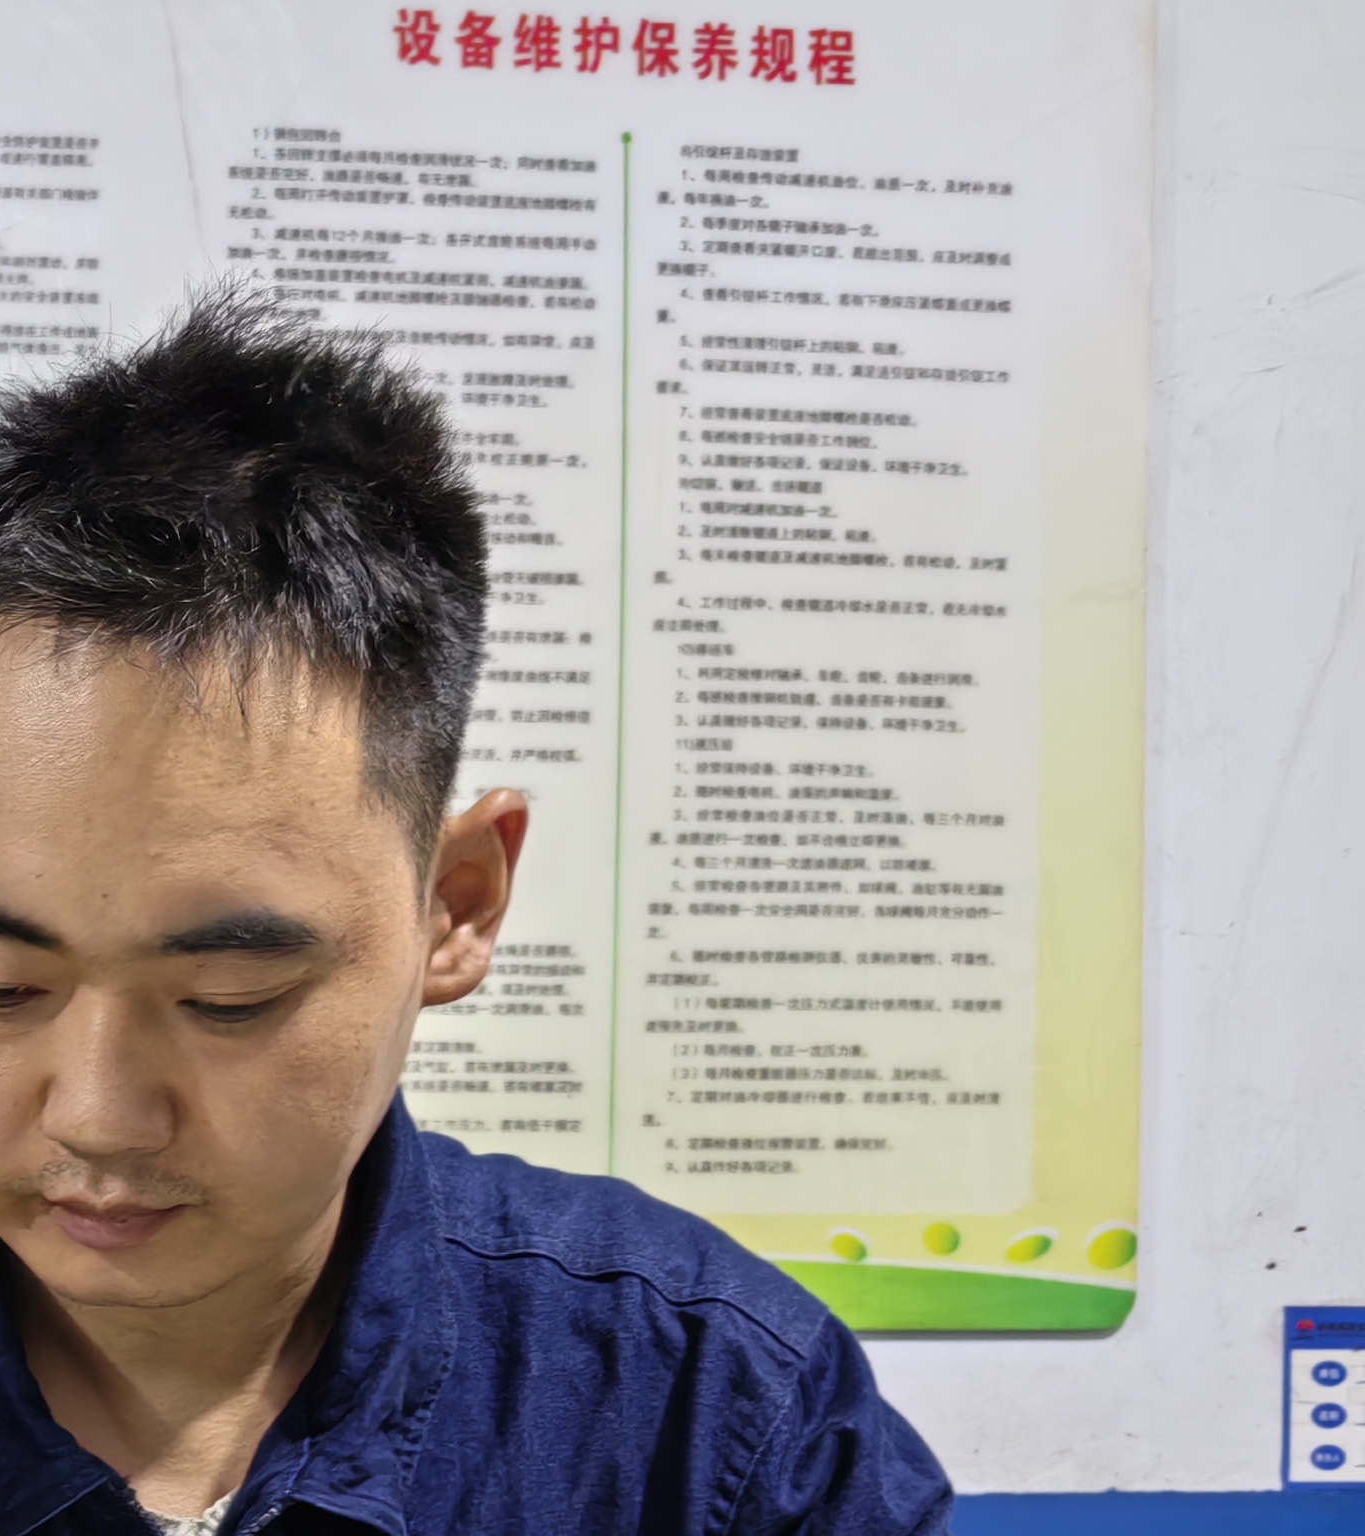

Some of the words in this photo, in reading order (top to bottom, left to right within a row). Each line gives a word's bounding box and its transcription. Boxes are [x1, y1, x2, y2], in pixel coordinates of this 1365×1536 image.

[393, 8, 857, 86] 设备维护保养规程
